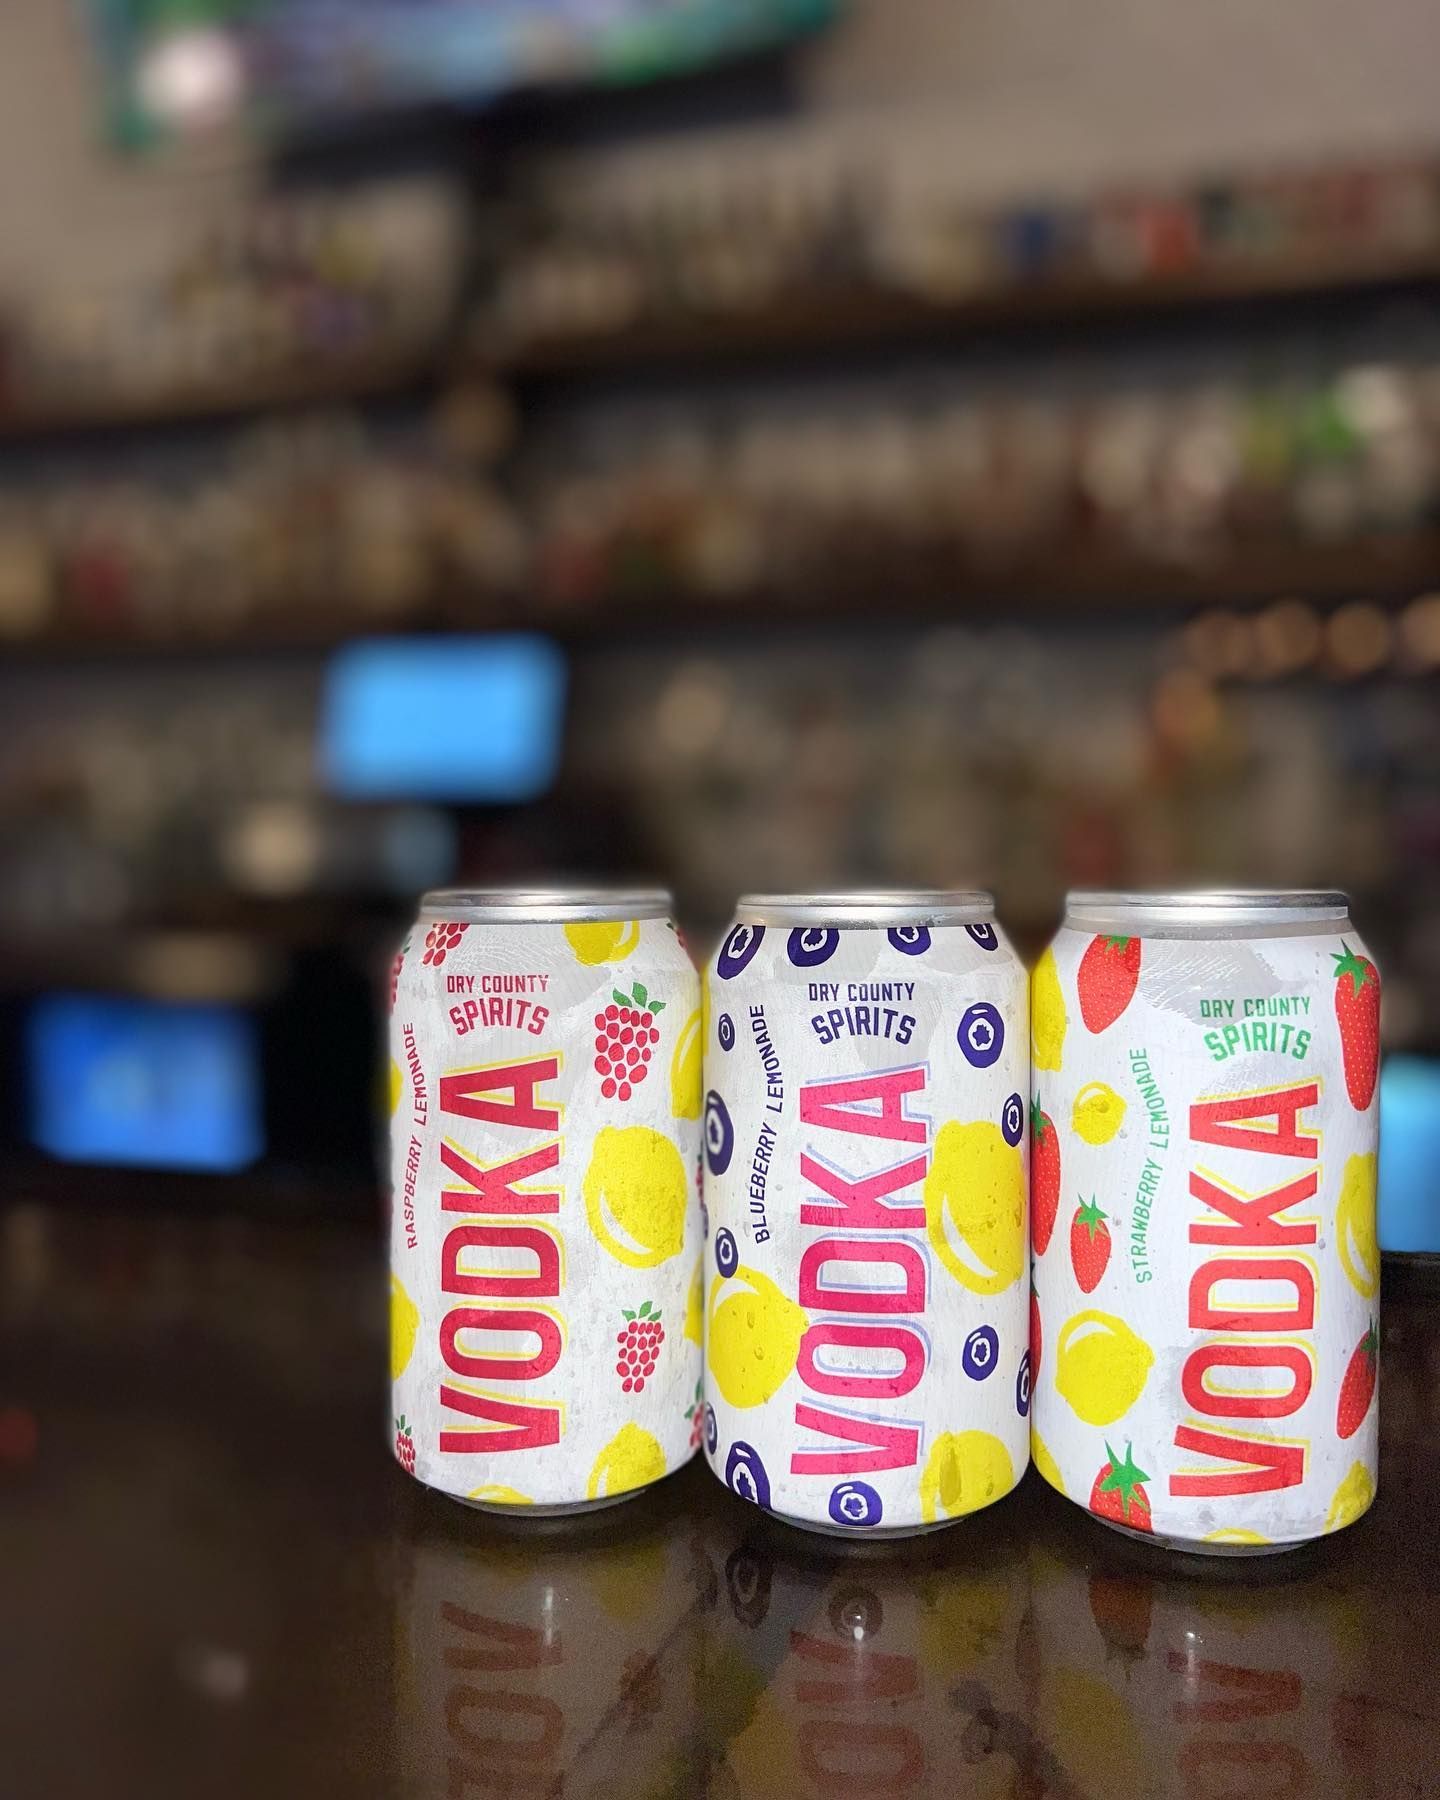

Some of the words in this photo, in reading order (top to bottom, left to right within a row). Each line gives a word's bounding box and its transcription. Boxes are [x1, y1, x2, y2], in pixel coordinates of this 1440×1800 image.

[447, 975, 474, 994] DRY
[482, 974, 550, 994] COUNTY
[449, 997, 550, 1036] SPIRITS
[808, 983, 840, 1002] DRY
[848, 982, 915, 1002] COUNTY
[811, 1006, 916, 1045] SPIRITS
[1200, 998, 1235, 1018] DRY
[1244, 996, 1311, 1017] COUNTY
[402, 1022, 428, 1126] LEMONADE
[749, 1004, 784, 1113] LEMONADE
[1203, 1021, 1312, 1061] SPIRITS
[1129, 1047, 1171, 1150] LEMONADE
[404, 1135, 424, 1249] RASPBERRY
[747, 1122, 778, 1244] BLUEBERRY
[1127, 1158, 1164, 1284] STRAWBERRY
[440, 1054, 565, 1453] VODKA
[790, 1063, 931, 1475] VODKA
[1169, 1078, 1323, 1496] VODKA
